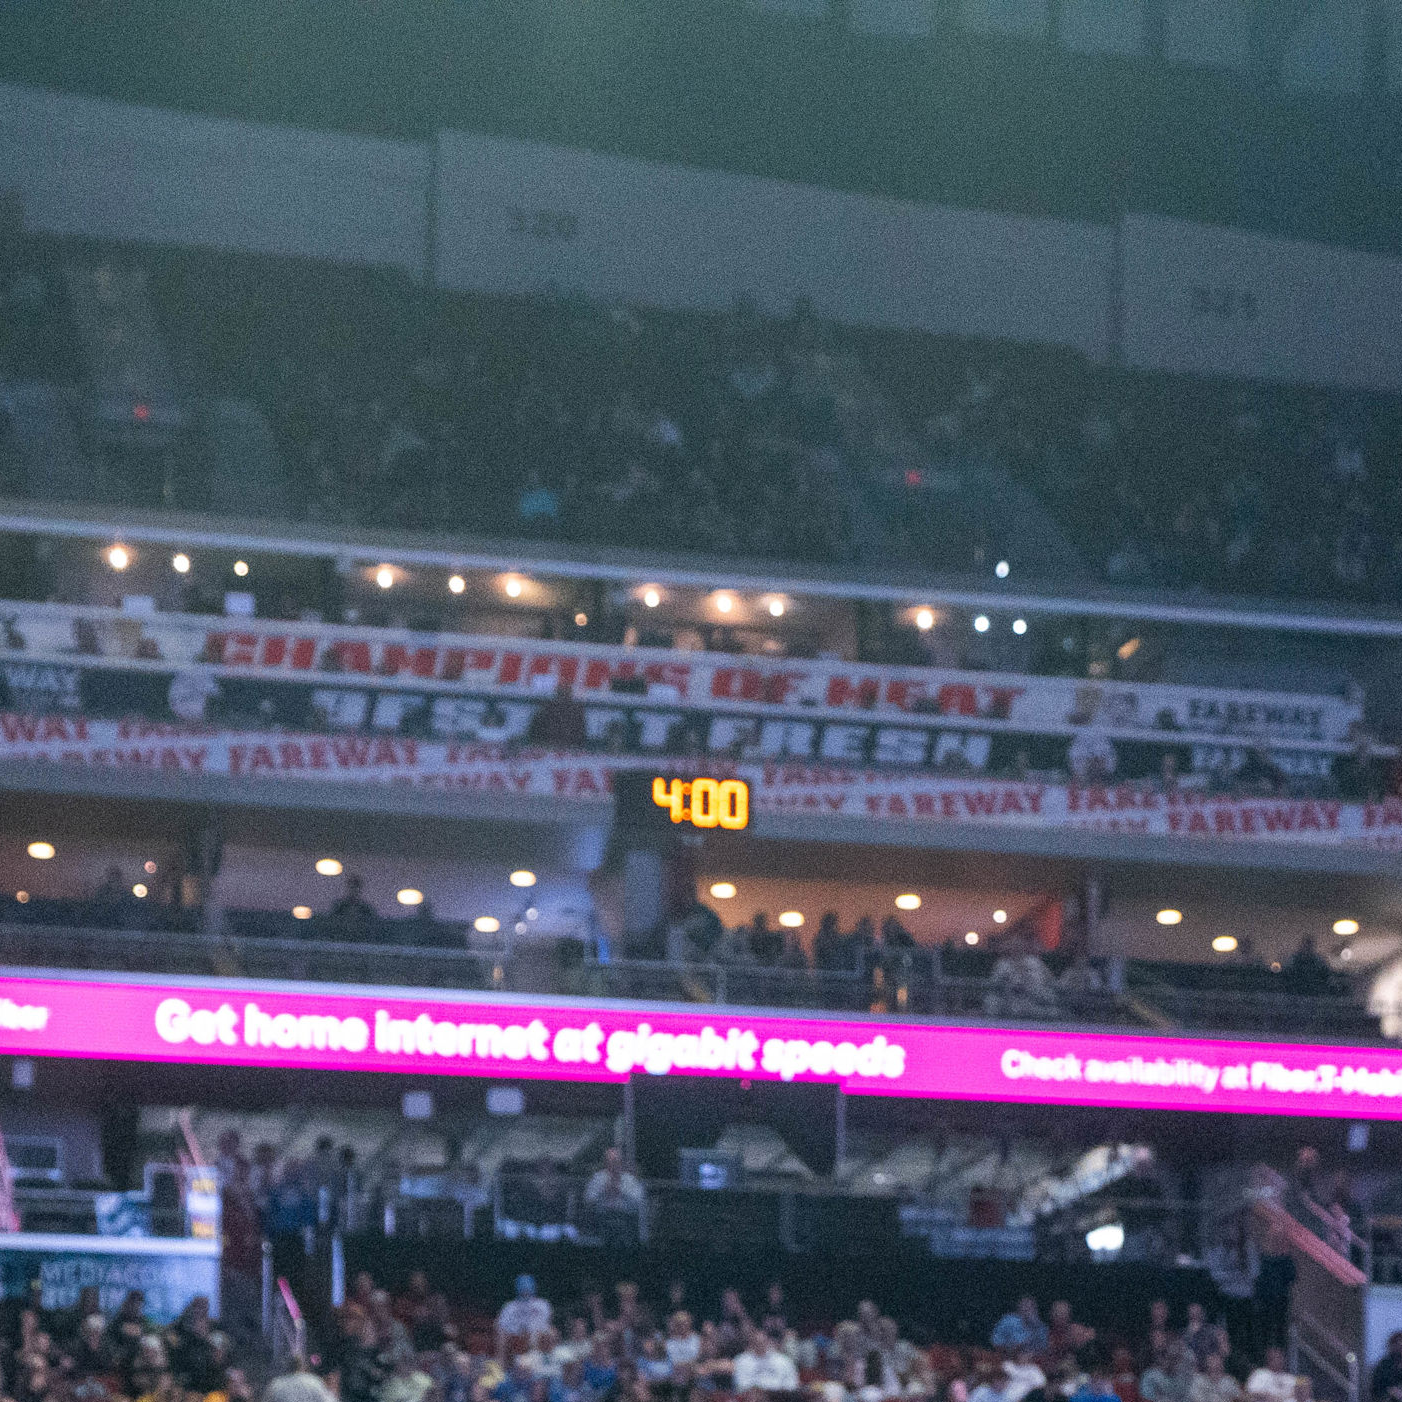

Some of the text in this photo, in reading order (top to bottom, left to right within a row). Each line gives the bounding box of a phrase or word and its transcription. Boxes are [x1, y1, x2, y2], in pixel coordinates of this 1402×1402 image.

[228, 738, 420, 774] FAREWAY
[652, 777, 749, 830] 4:00
[864, 784, 1043, 817] FAREWAY
[1167, 799, 1341, 834] FAREWAY
[155, 998, 906, 1079] Get home internet at gigabit speeds
[1001, 1049, 1082, 1080] Check
[1221, 1066, 1249, 1088] at
